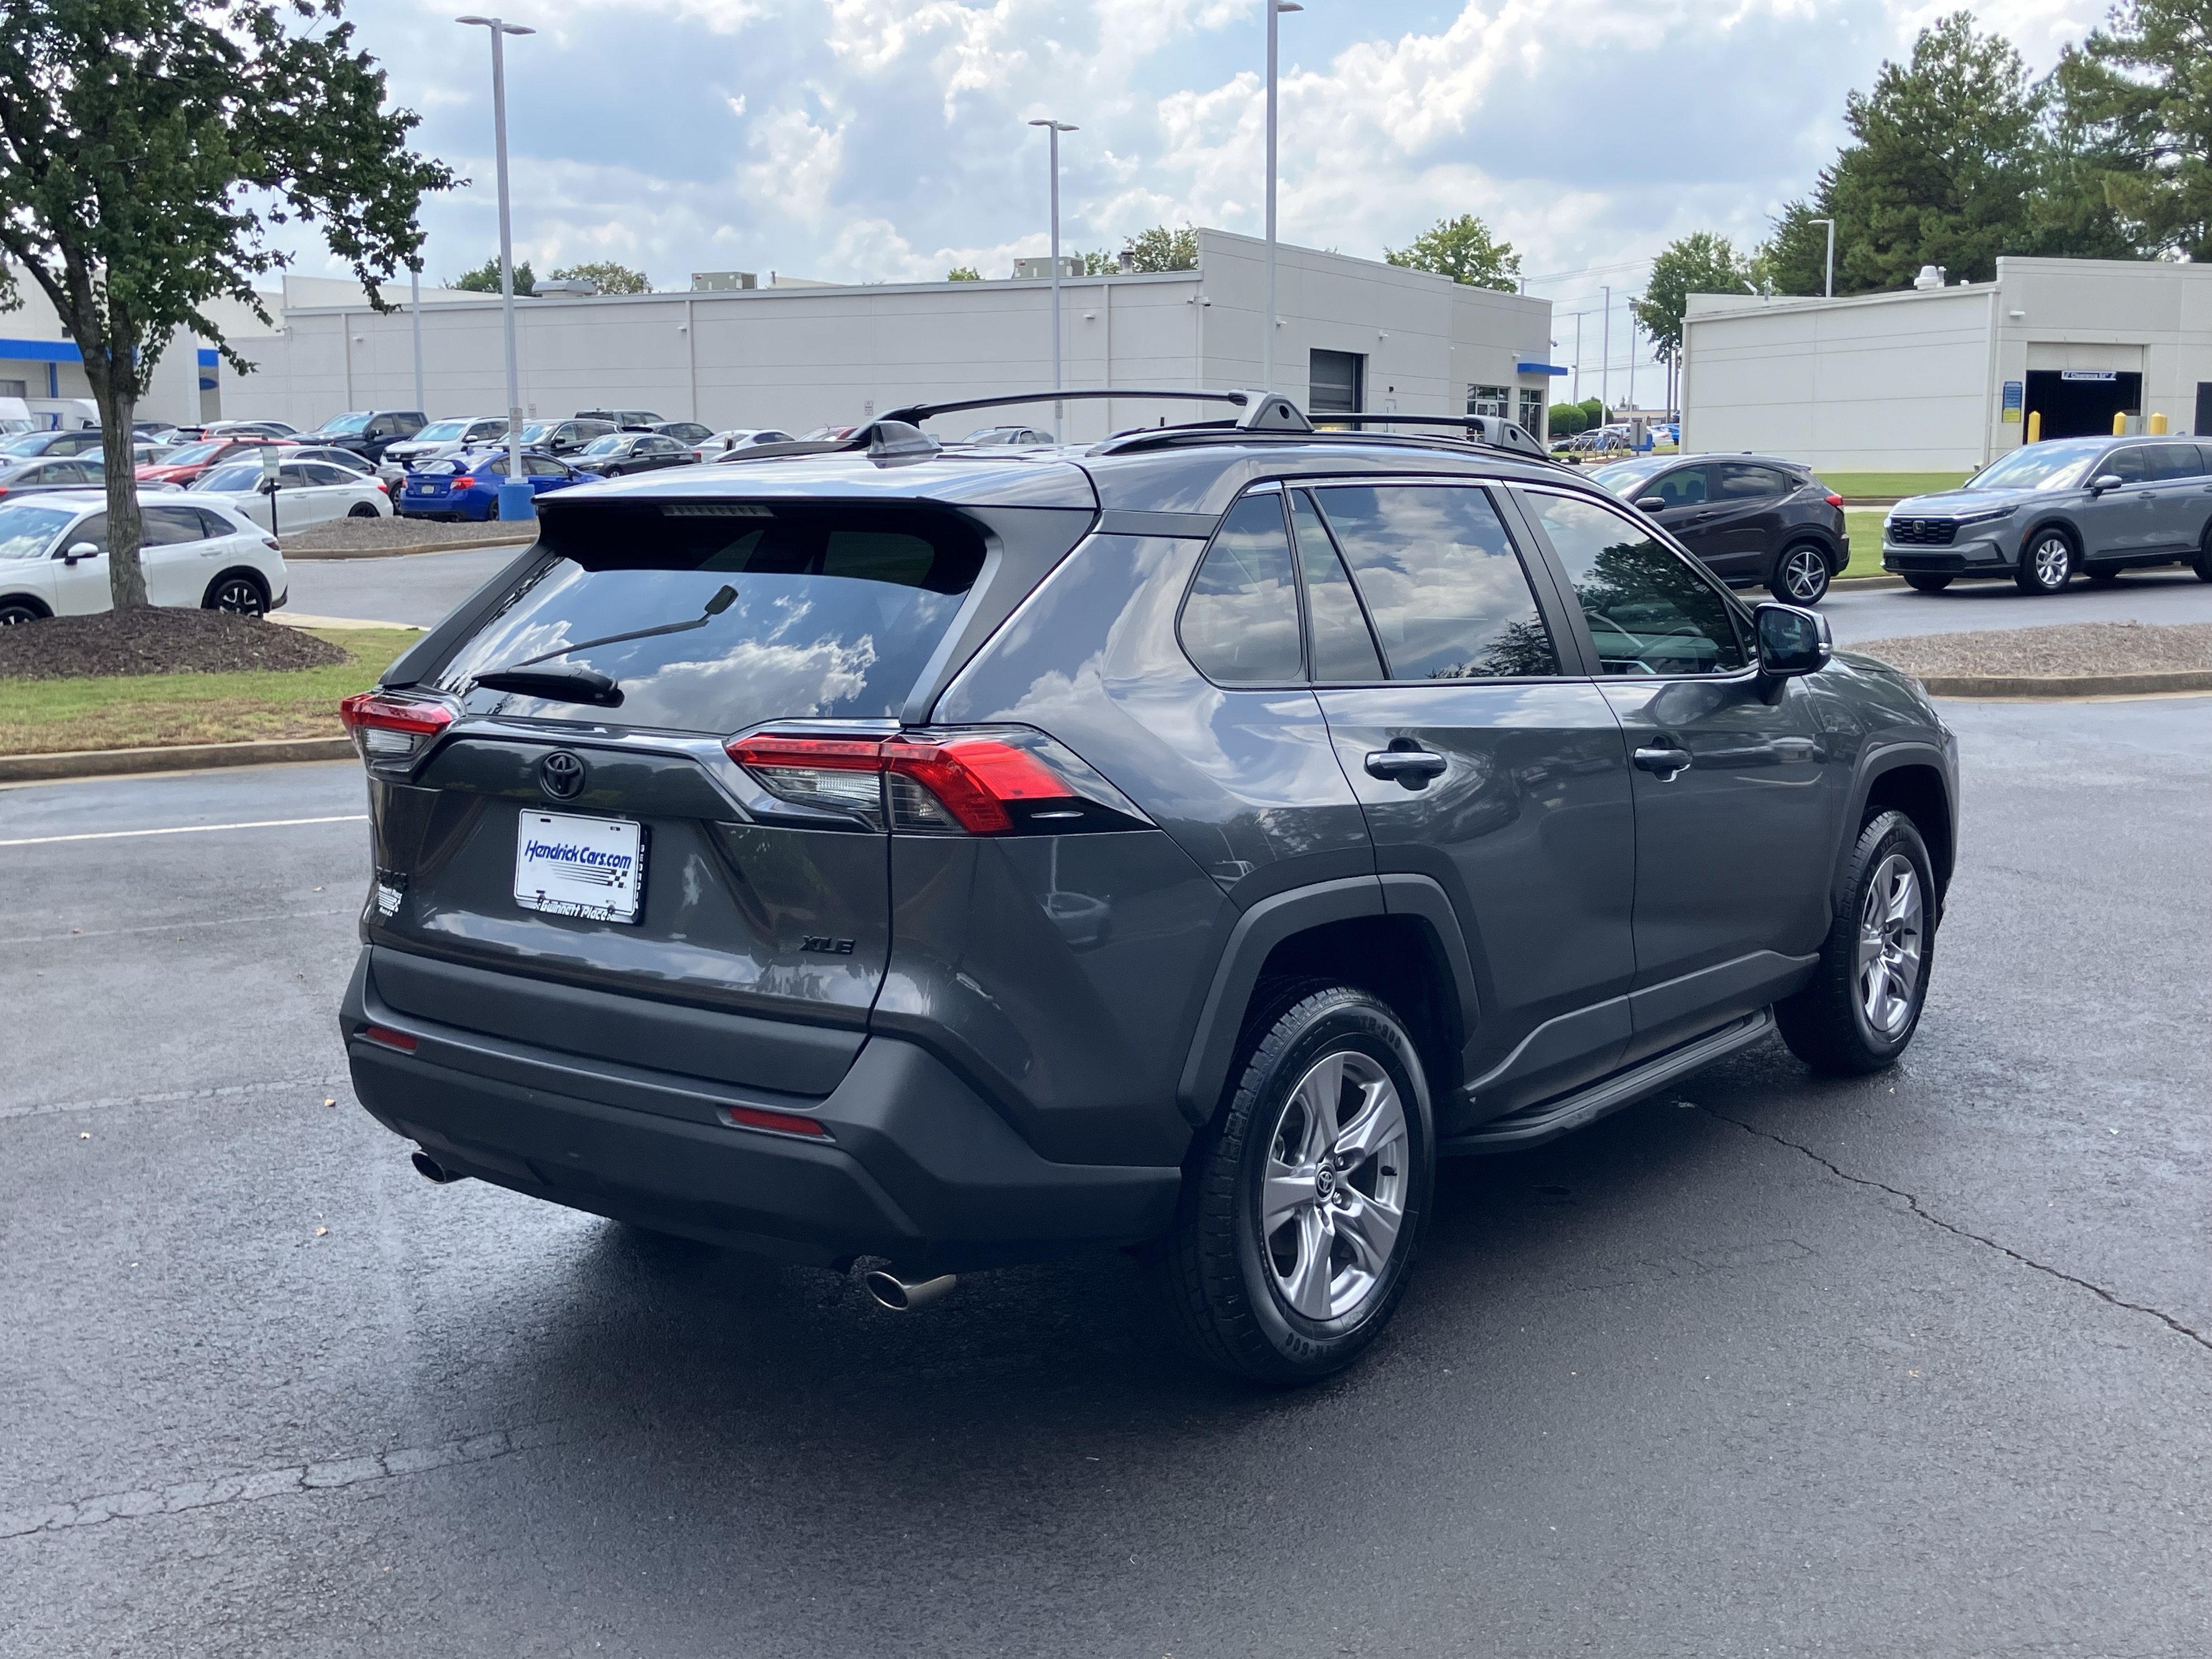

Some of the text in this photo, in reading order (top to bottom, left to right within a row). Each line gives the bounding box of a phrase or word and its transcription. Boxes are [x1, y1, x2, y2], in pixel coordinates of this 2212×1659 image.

[540, 899, 607, 921] Gwinnett Place
[799, 935, 856, 955] XLE
